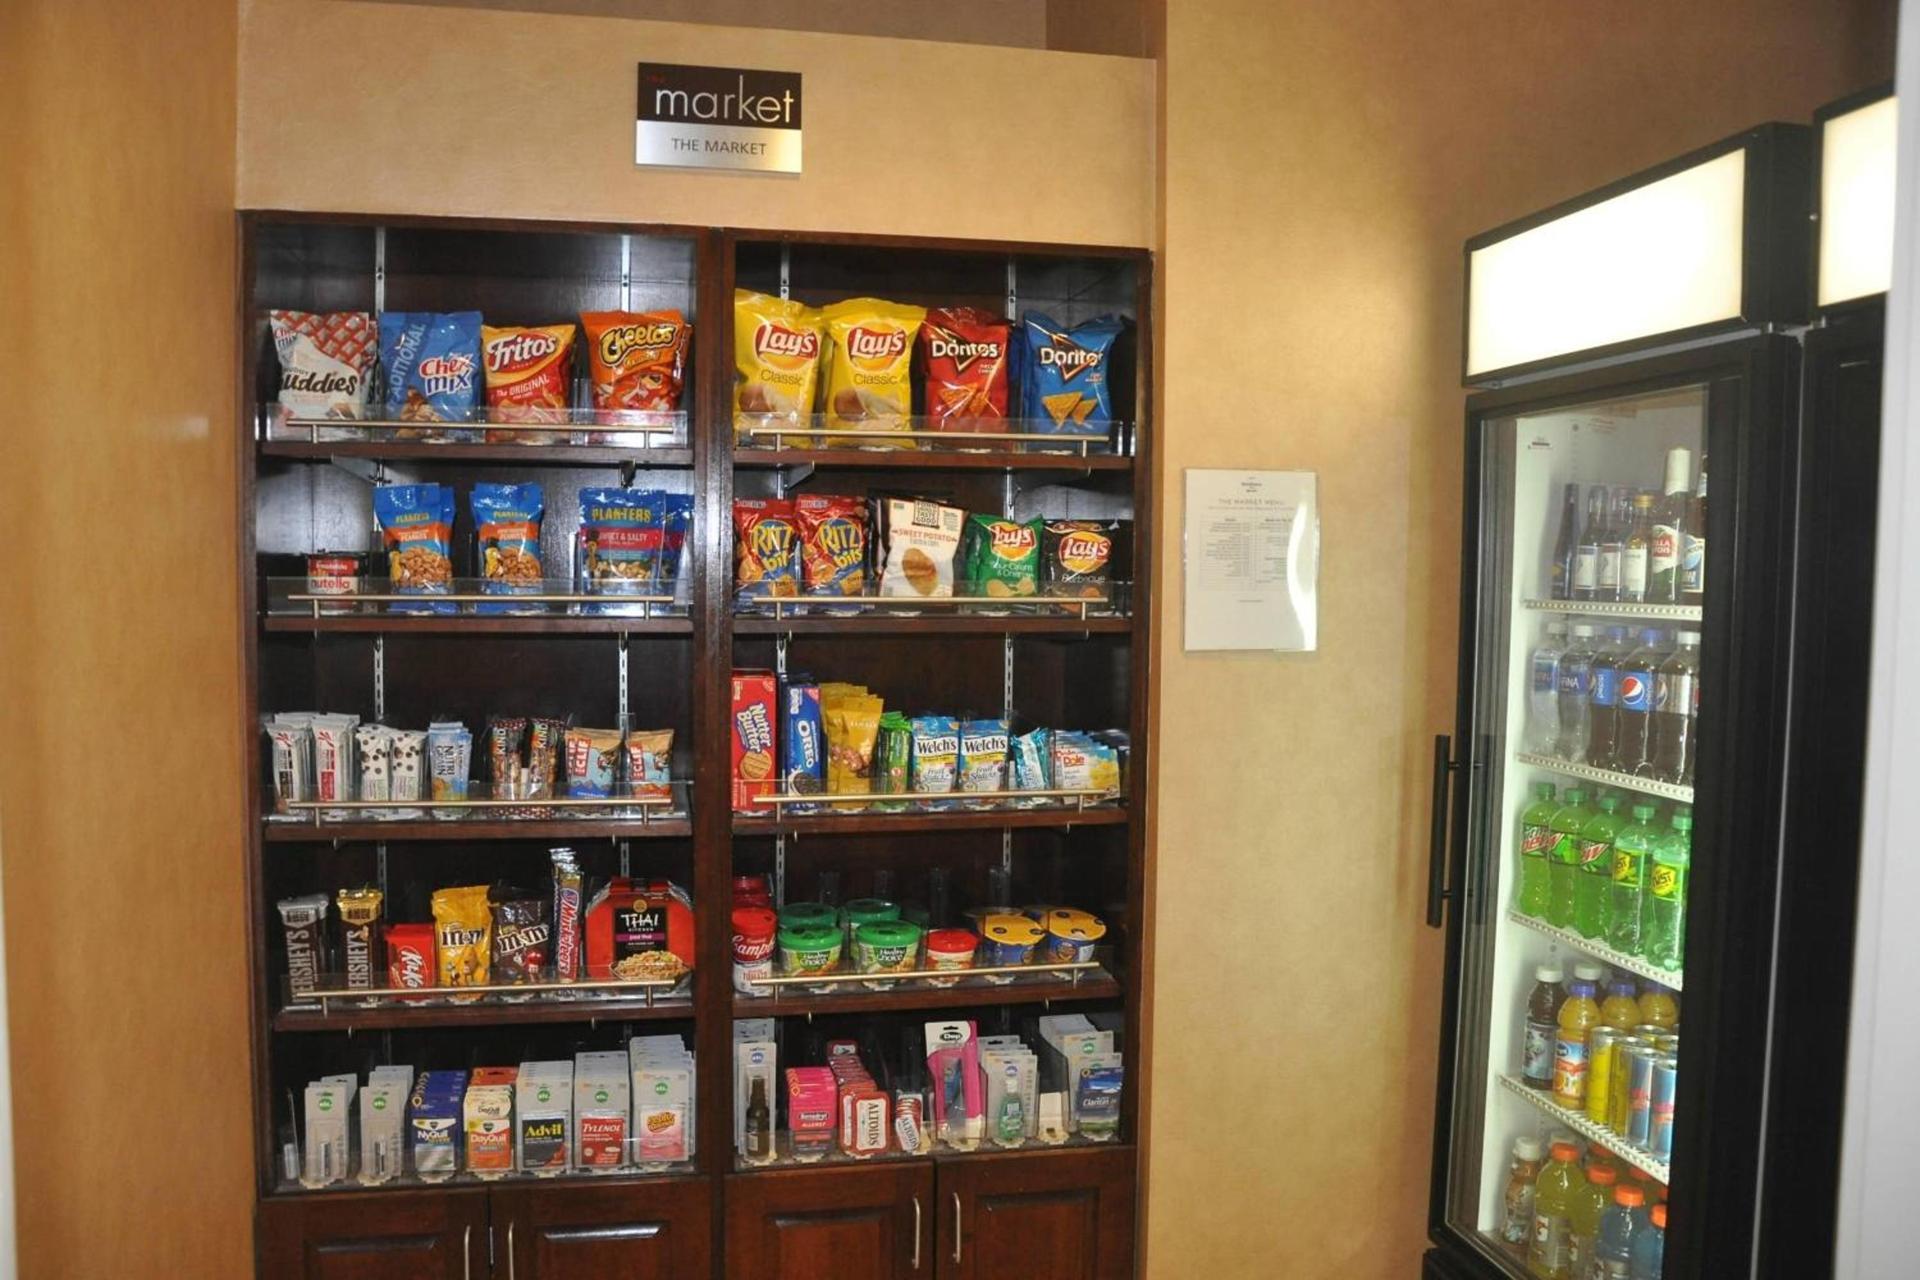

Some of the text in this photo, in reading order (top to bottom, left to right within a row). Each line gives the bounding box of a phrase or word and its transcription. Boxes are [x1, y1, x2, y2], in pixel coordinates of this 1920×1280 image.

[656, 75, 794, 123] market
[672, 138, 767, 155] THE MARKET
[601, 324, 675, 366] Cheetos
[759, 325, 815, 356] Lay's
[851, 328, 904, 357] Lay's
[932, 340, 998, 358] Doritos
[487, 336, 556, 372] Fritos
[281, 372, 358, 396] uddies
[426, 369, 472, 396] mix
[509, 374, 549, 396] ORIGINAL
[761, 369, 803, 385] Classic
[854, 373, 897, 385] Classic
[592, 507, 651, 522] PLANTERS
[753, 525, 793, 553] RITZ
[819, 524, 858, 553] RITZ
[993, 526, 1032, 546] Lay's
[834, 549, 863, 569] bits
[1064, 538, 1110, 560] Lay's
[310, 578, 351, 589] nutella
[538, 723, 549, 749] KIND
[737, 711, 761, 752] Butter
[749, 703, 771, 747] Nutter
[496, 728, 507, 755] KIND
[576, 740, 589, 767] CLIF
[797, 721, 814, 768] OREO
[917, 739, 957, 754] Welch's
[964, 738, 1006, 752] Welch's
[631, 746, 643, 772] CLIF
[1063, 755, 1085, 767] Dole
[620, 914, 658, 928] THAI
[347, 930, 369, 992] ERSHEY'S
[525, 1123, 562, 1137] Advil
[583, 1123, 620, 1133] TYLENOL
[869, 1103, 879, 1146] ALTOIDS
[470, 1134, 507, 1145] DayQuil
